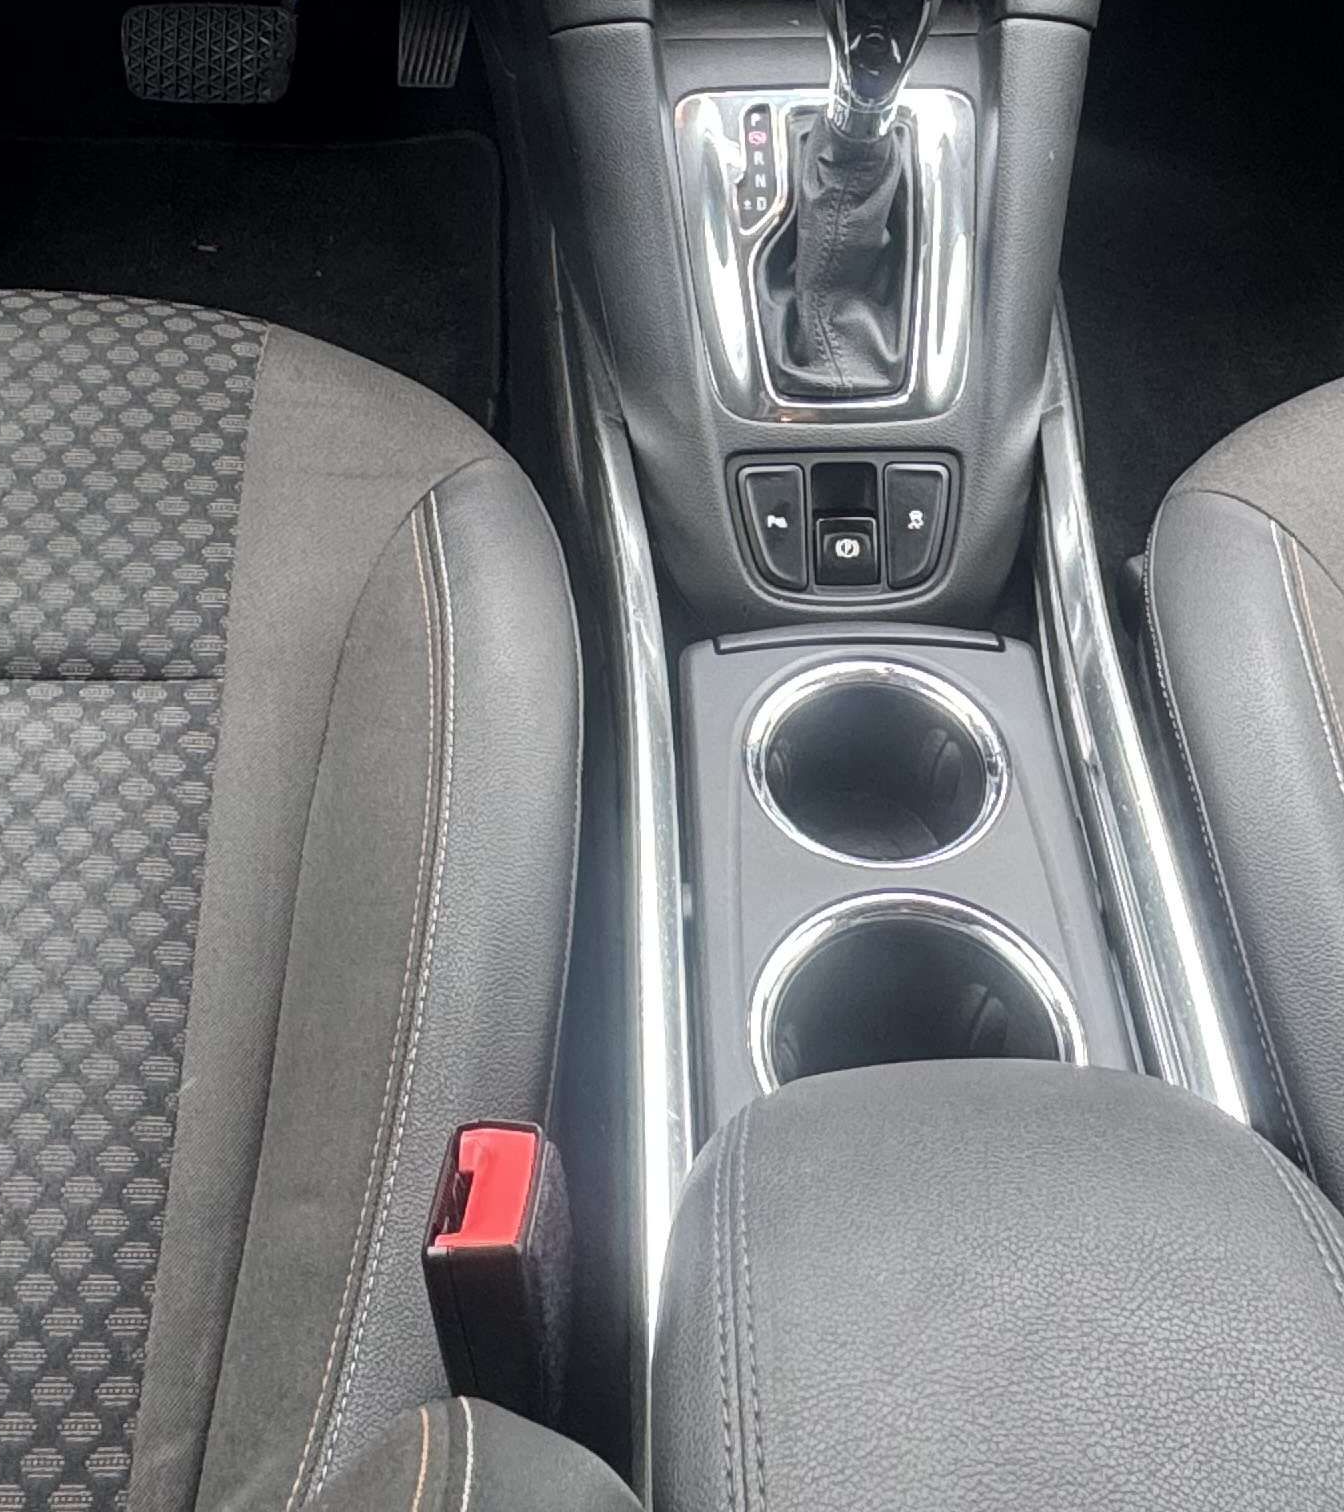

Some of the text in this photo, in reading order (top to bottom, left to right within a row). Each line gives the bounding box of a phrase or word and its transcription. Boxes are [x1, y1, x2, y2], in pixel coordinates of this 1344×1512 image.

[751, 113, 760, 126] P
[754, 150, 765, 166] R
[755, 173, 767, 188] N
[757, 196, 767, 211] D
